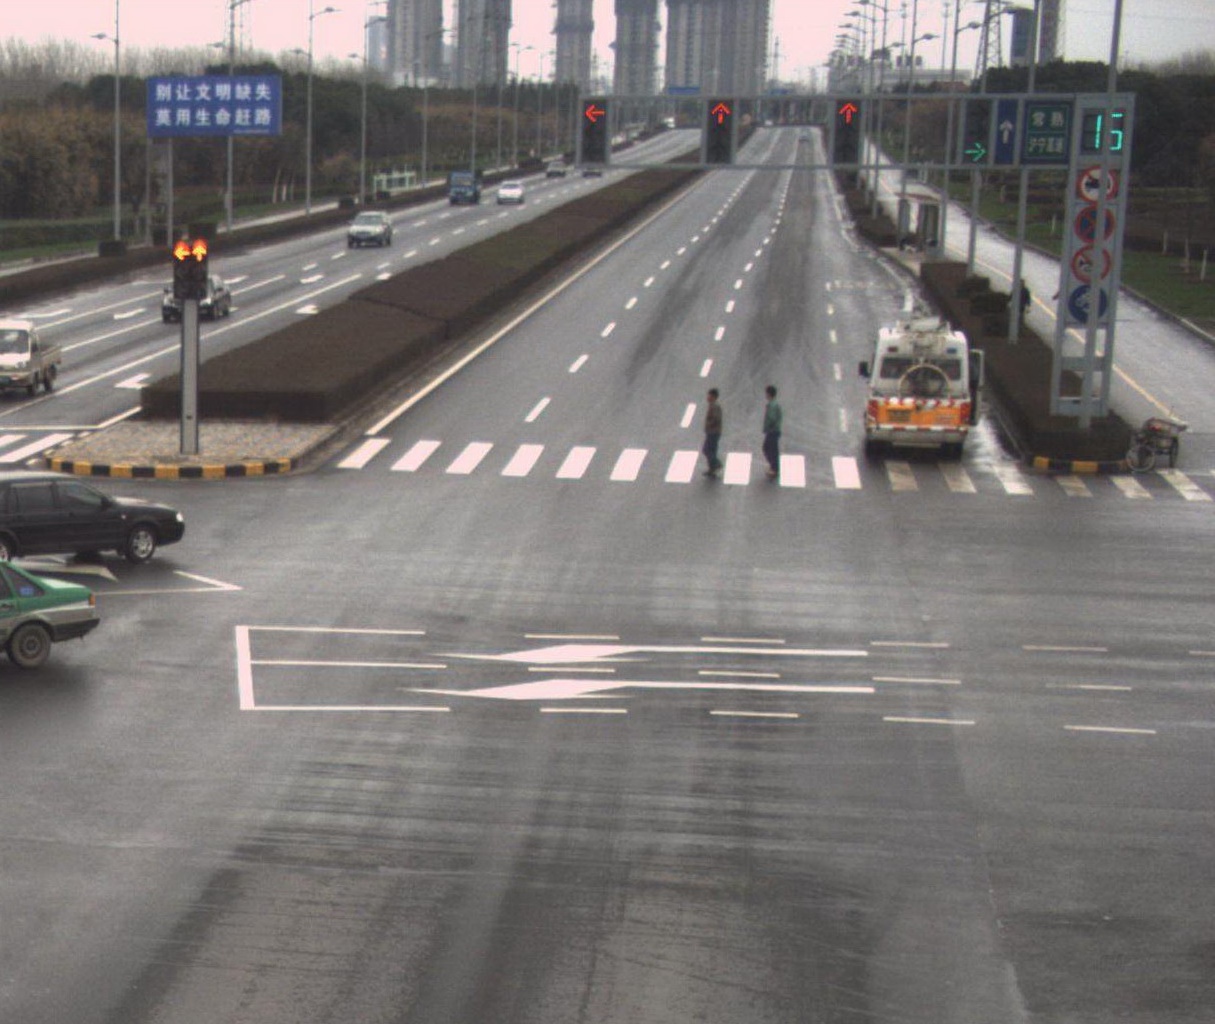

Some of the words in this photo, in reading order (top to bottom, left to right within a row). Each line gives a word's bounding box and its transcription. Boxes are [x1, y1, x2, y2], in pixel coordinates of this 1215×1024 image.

[156, 83, 271, 101] 别让文明缺失
[155, 108, 272, 126] 莫用生命赶路
